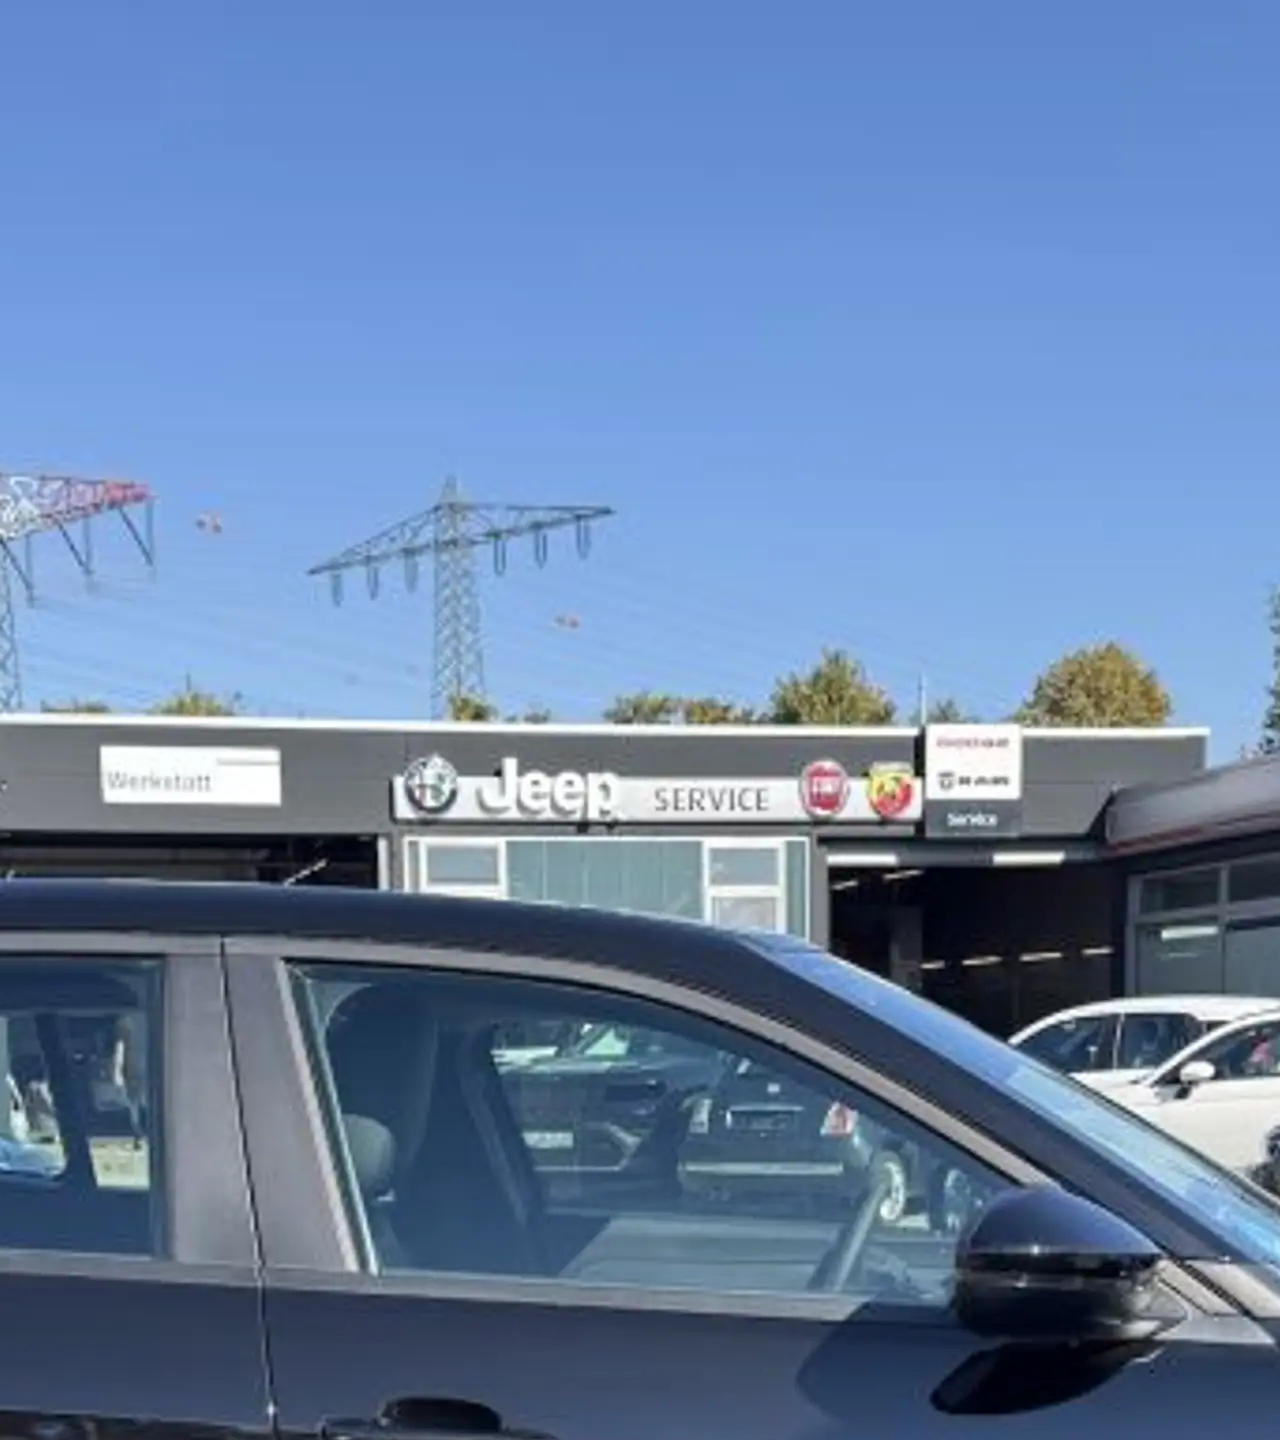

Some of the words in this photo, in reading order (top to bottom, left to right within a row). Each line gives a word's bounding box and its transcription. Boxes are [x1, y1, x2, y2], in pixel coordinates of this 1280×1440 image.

[107, 771, 212, 792] Werkstatt
[475, 757, 623, 822] Jeep
[654, 787, 770, 812] SERVICE
